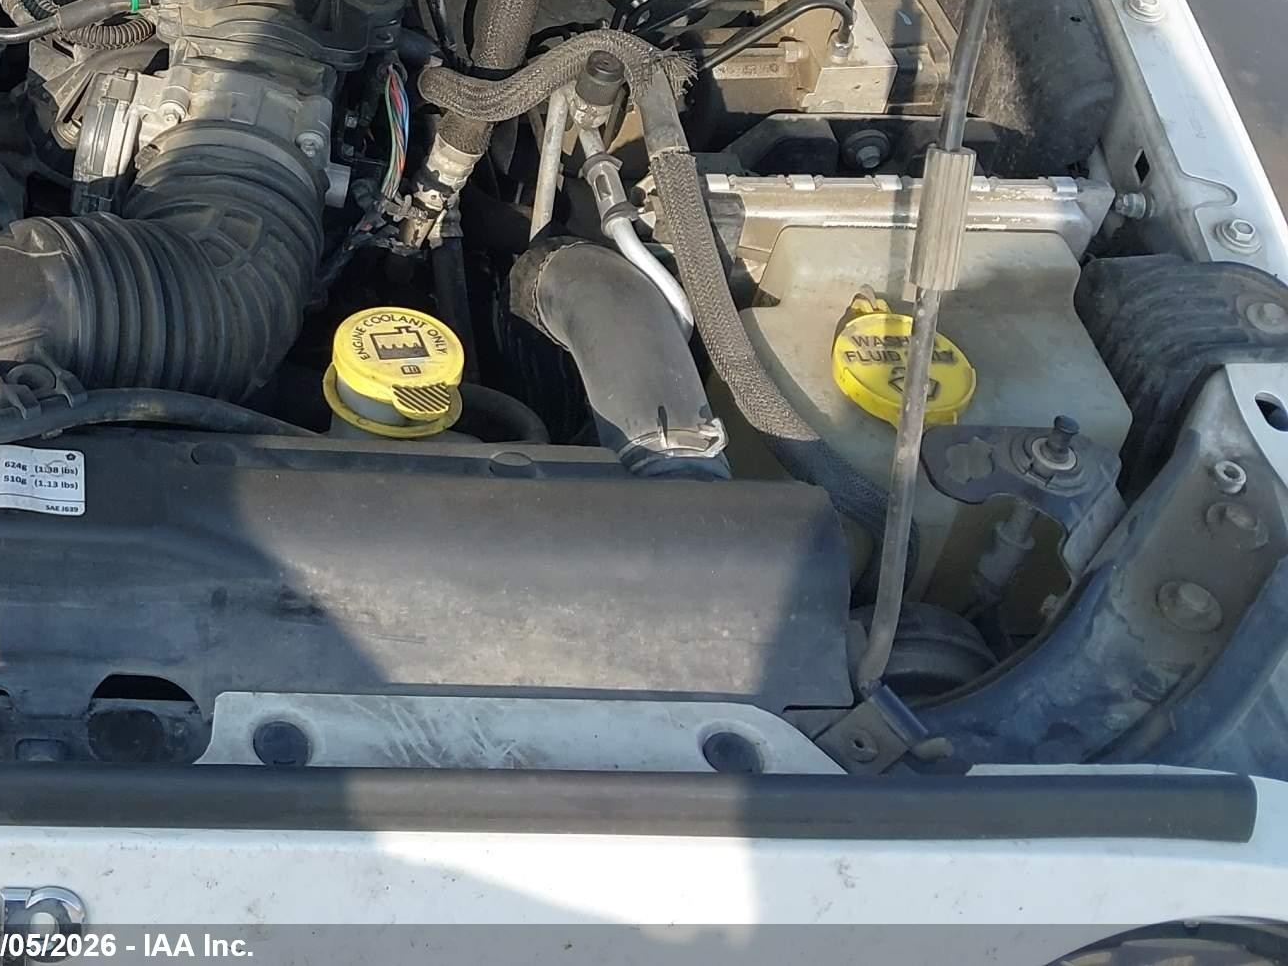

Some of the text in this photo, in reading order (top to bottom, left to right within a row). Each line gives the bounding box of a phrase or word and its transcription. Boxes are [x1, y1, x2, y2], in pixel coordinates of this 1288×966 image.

[352, 314, 449, 361] ENGINE COOLANT ONLY
[844, 350, 901, 363] FLUID
[4, 461, 28, 471] 624g
[61, 466, 78, 475] lbs)
[3, 475, 27, 485] 510g
[34, 481, 59, 489] (1.13
[61, 481, 78, 490] lbs)
[45, 504, 60, 512] SAE
